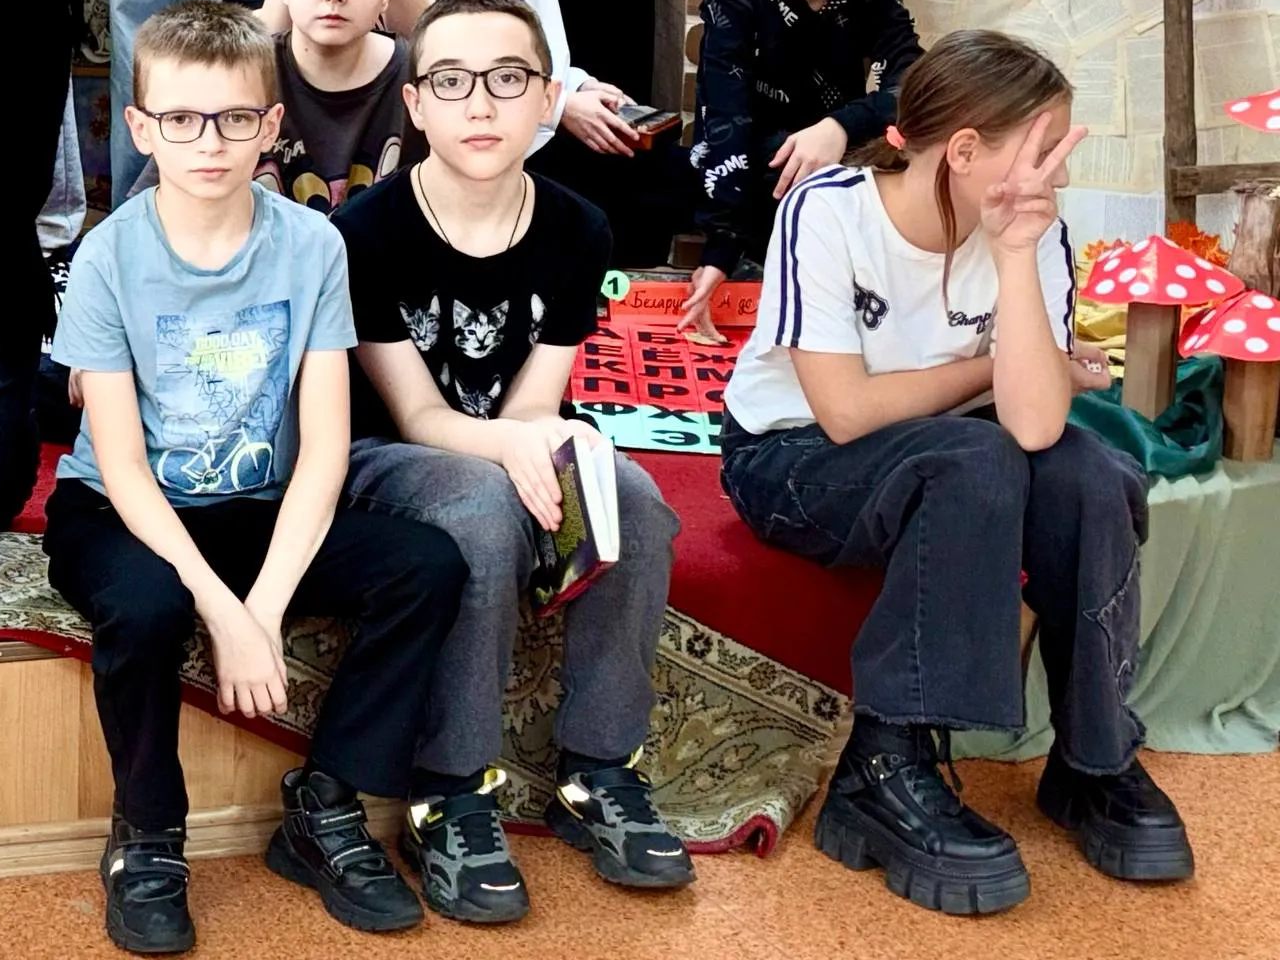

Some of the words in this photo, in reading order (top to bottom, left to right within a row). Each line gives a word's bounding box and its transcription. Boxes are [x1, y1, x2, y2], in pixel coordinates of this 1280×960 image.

[607, 277, 619, 295] 1
[583, 376, 630, 395] П
[647, 383, 691, 400] Р
[579, 401, 639, 416] Ф
[646, 404, 700, 424] Х
[650, 429, 701, 446] Э
